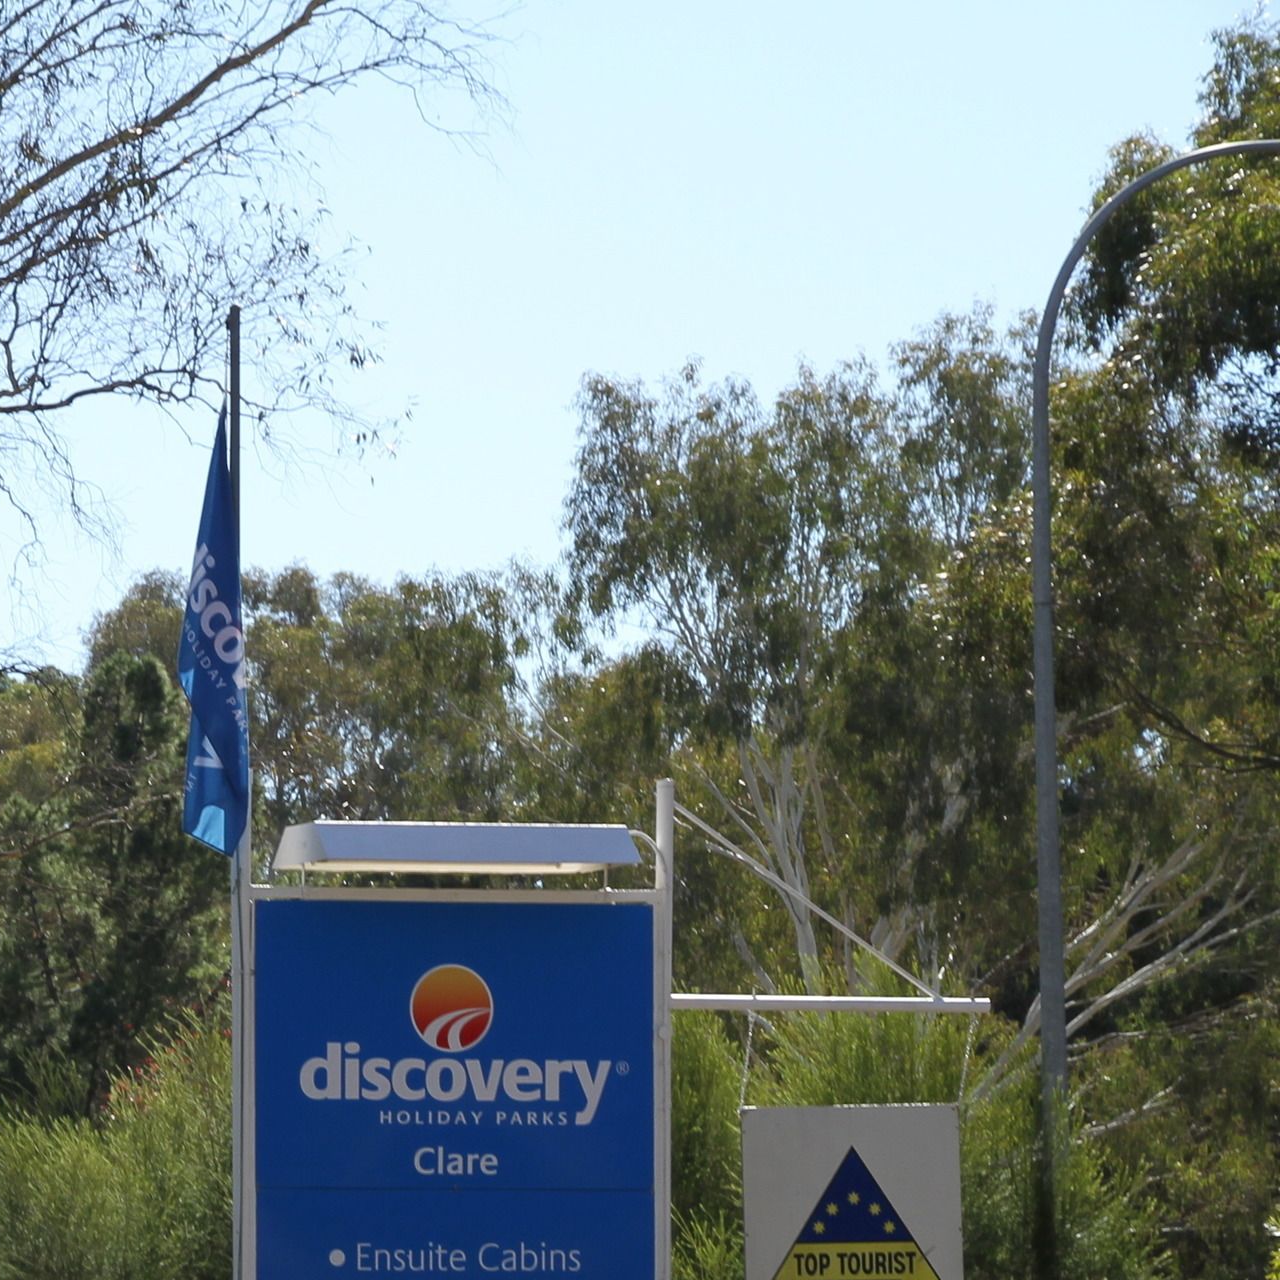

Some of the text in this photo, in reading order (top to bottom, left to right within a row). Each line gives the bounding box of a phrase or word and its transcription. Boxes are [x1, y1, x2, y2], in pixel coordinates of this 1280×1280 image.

[299, 1041, 612, 1125] discovery
[379, 1110, 568, 1126] HOLIDAY PARKS
[413, 1146, 498, 1176] Clare
[356, 1241, 582, 1272] Ensuite Cabins
[793, 1251, 916, 1276] TOP TOURIST
